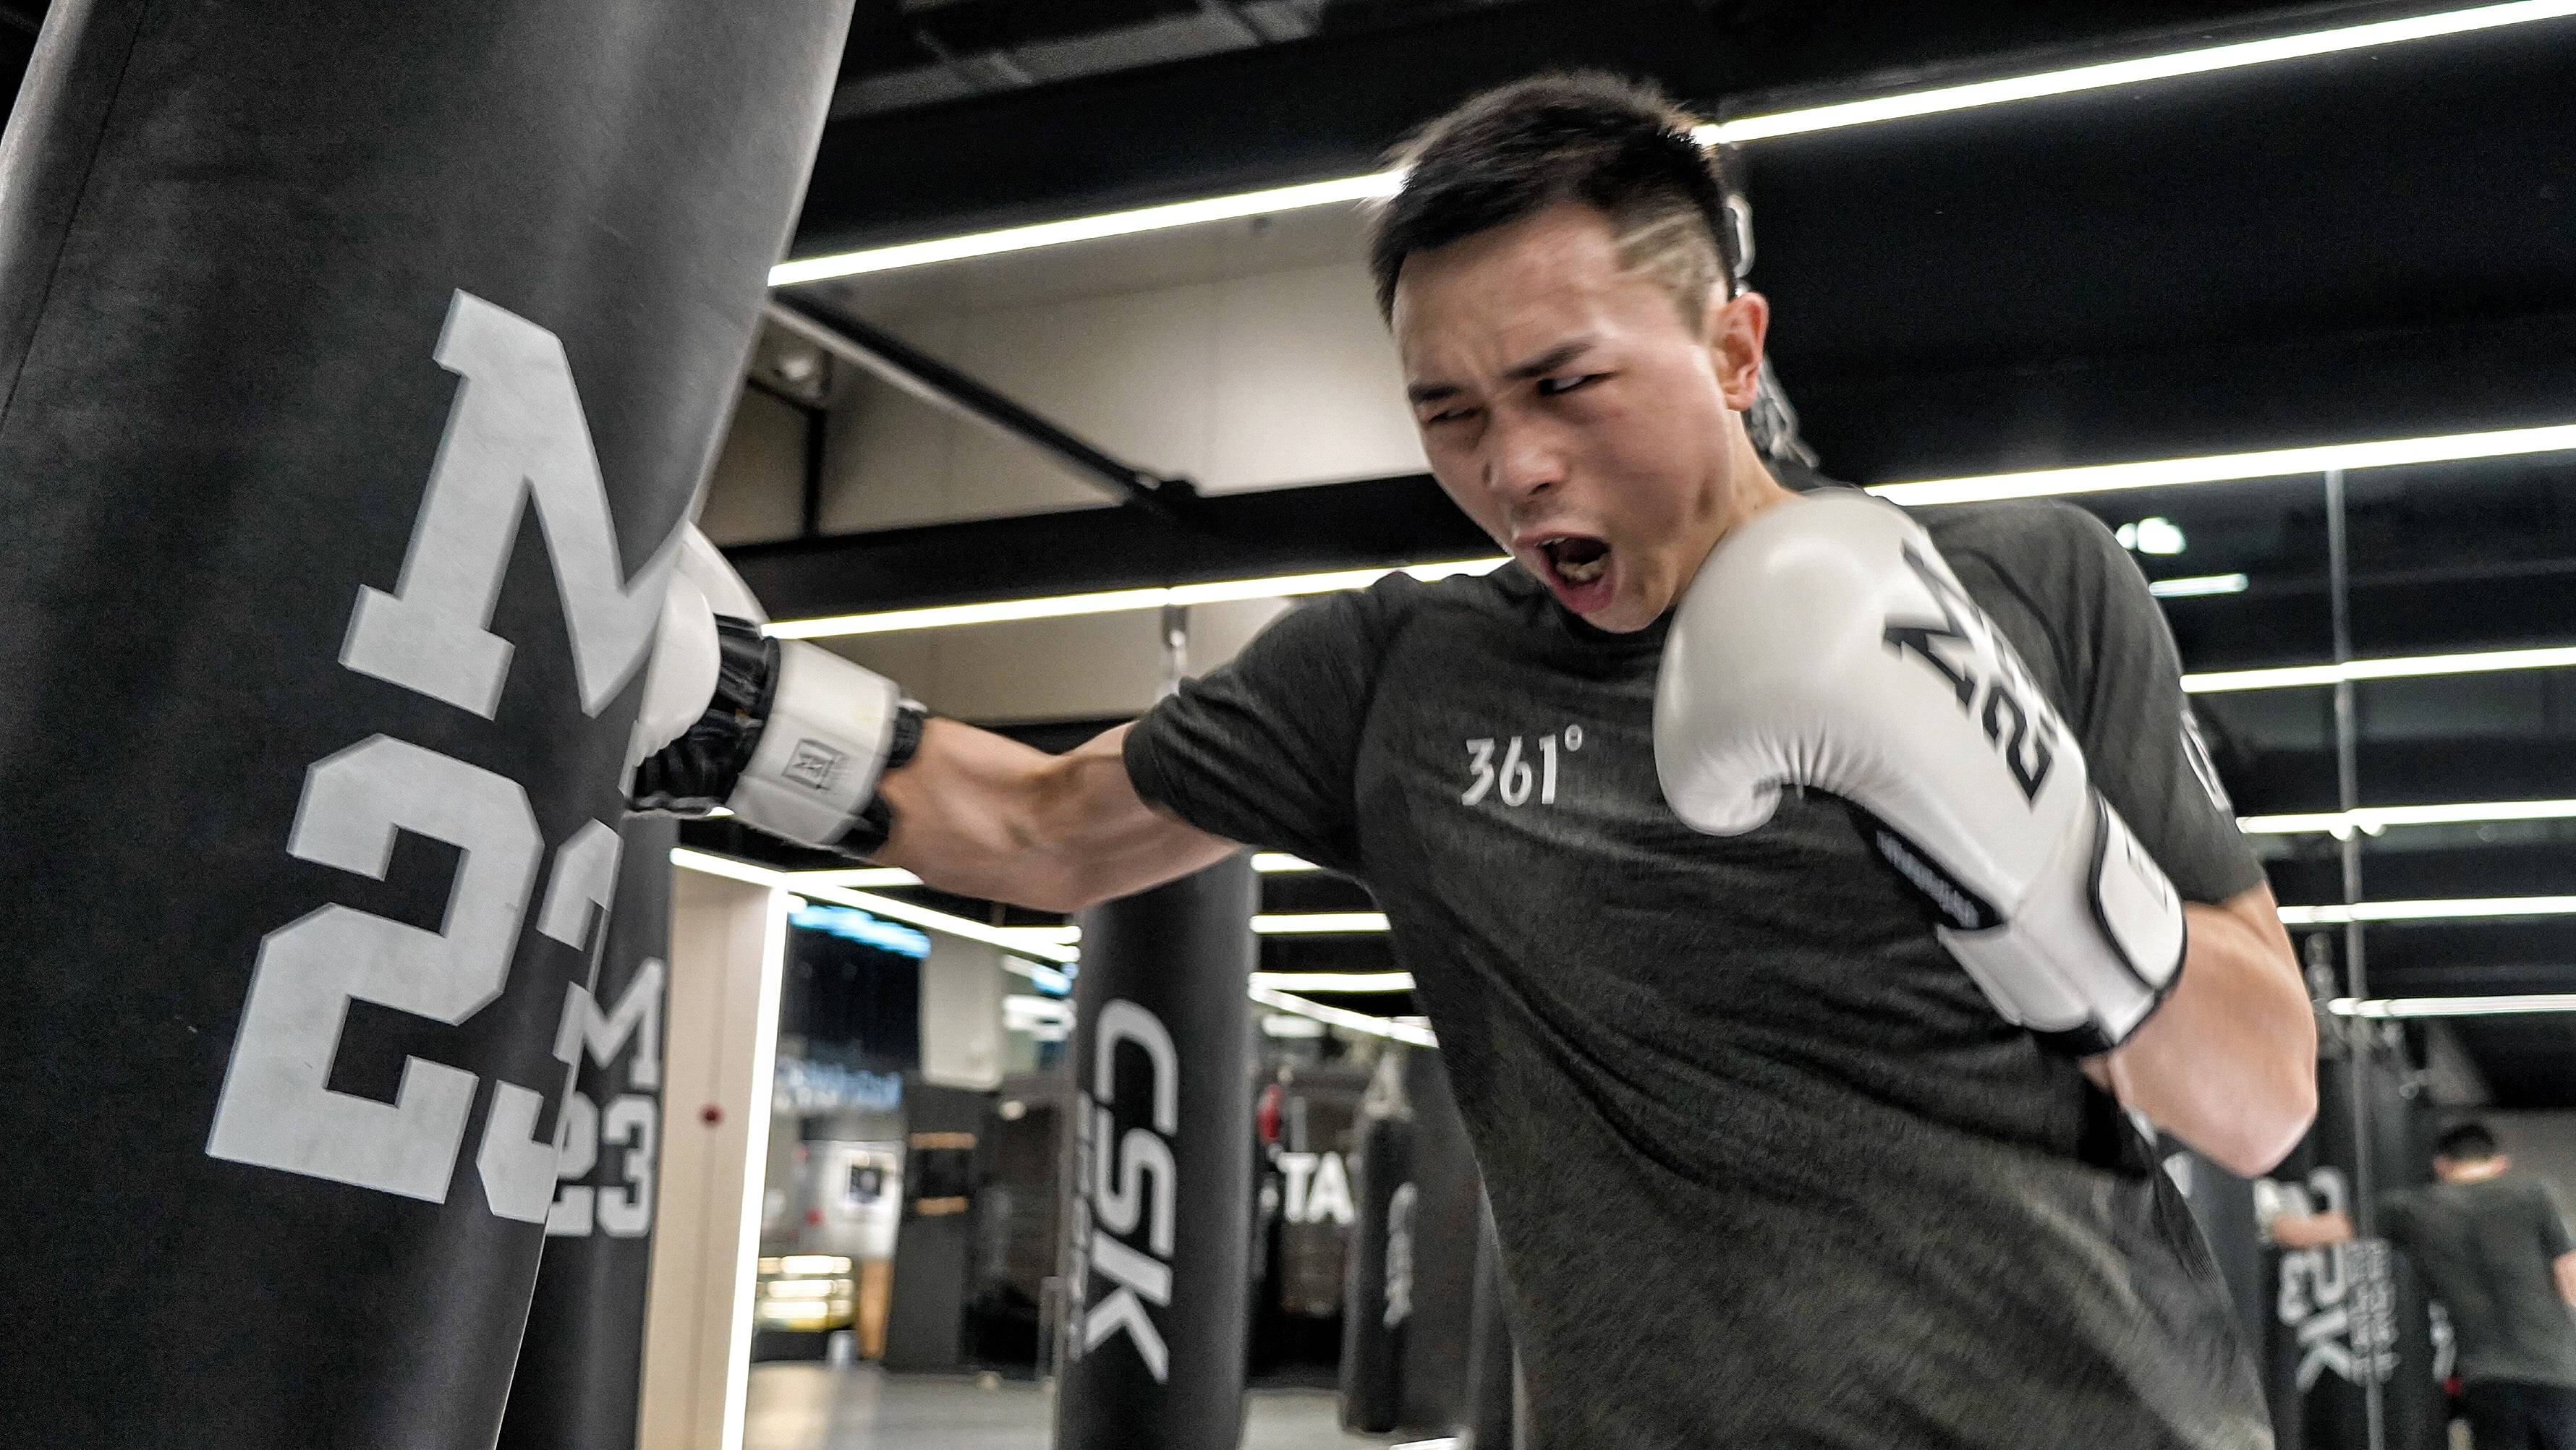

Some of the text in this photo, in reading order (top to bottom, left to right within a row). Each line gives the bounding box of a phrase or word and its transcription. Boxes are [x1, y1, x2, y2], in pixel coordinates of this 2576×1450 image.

[338, 288, 689, 720] M
[1085, 999, 1178, 1383] CSK
[1262, 1150, 1354, 1224] TA
